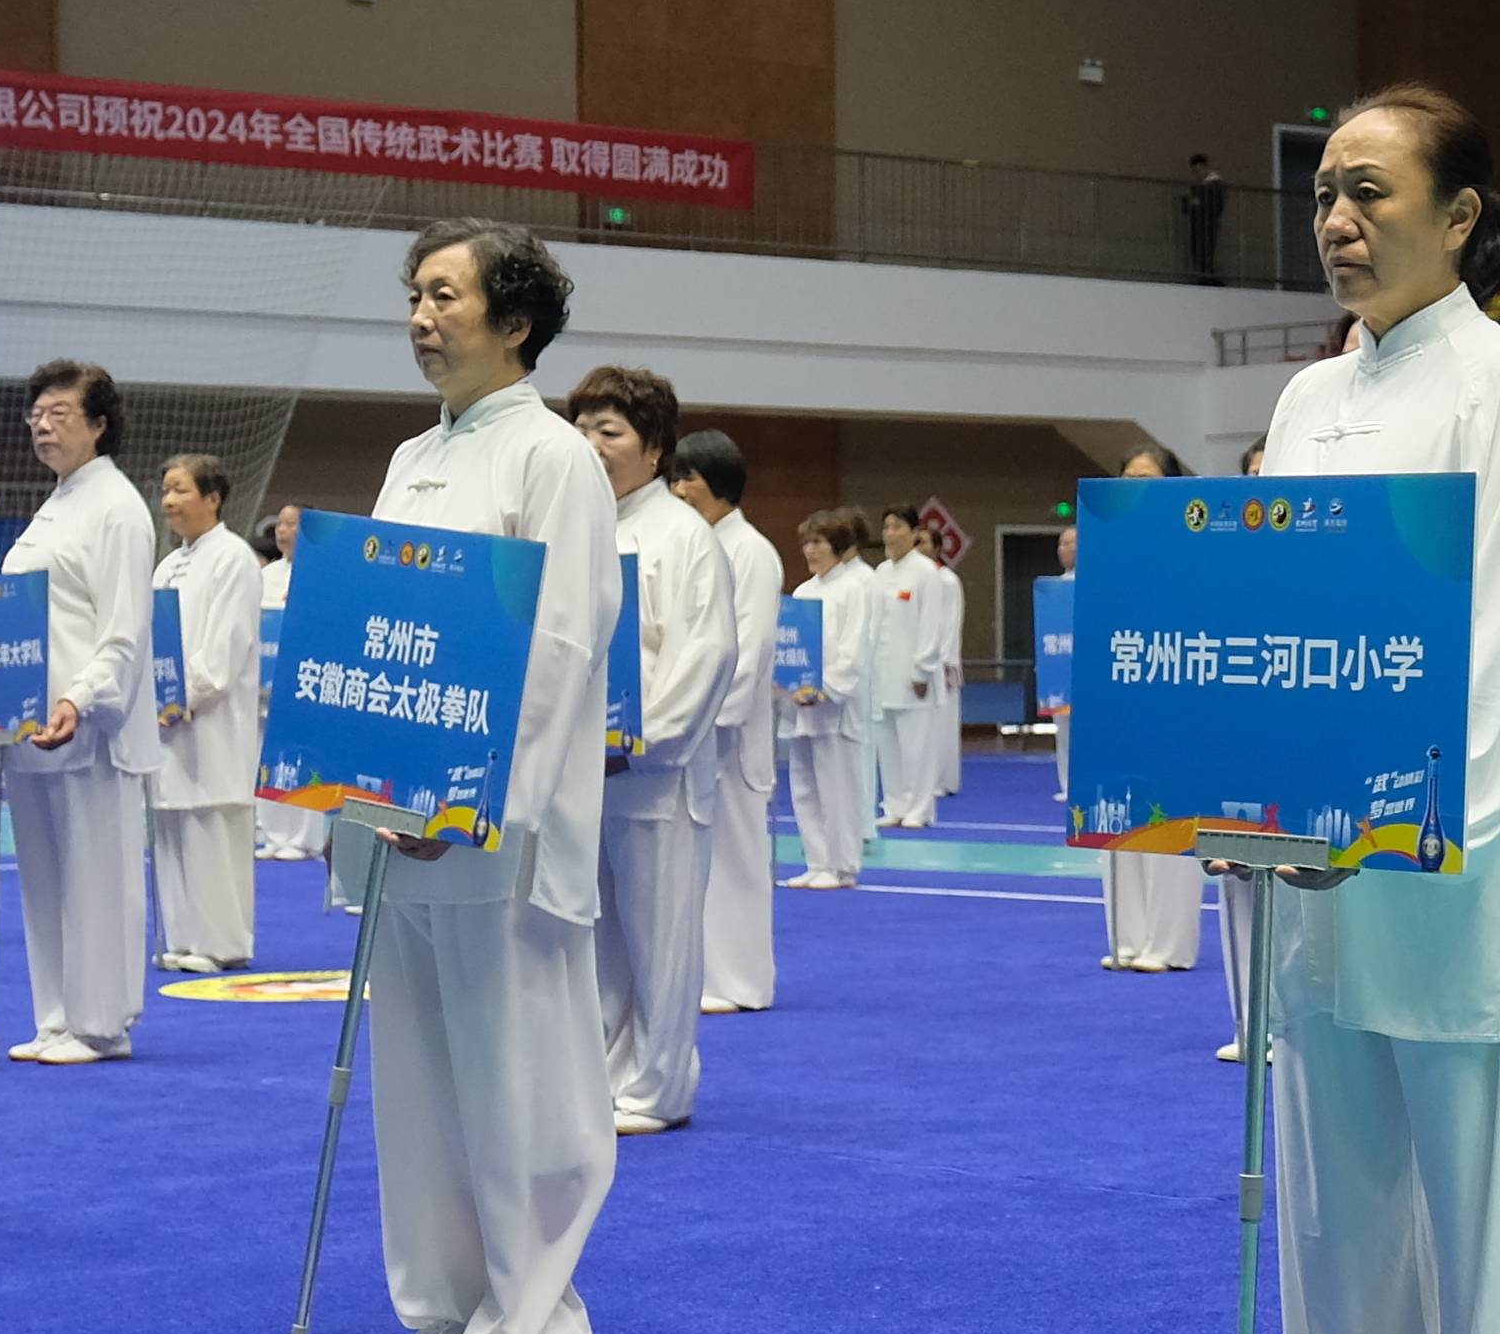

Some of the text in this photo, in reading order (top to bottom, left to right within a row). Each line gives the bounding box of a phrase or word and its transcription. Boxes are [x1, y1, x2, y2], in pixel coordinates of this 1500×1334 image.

[550, 135, 729, 190] 取得圆满成功
[363, 615, 440, 668] 常州市
[1108, 628, 1425, 694] 常州市三河口小学
[295, 658, 491, 736] 安徽商会太极拳队
